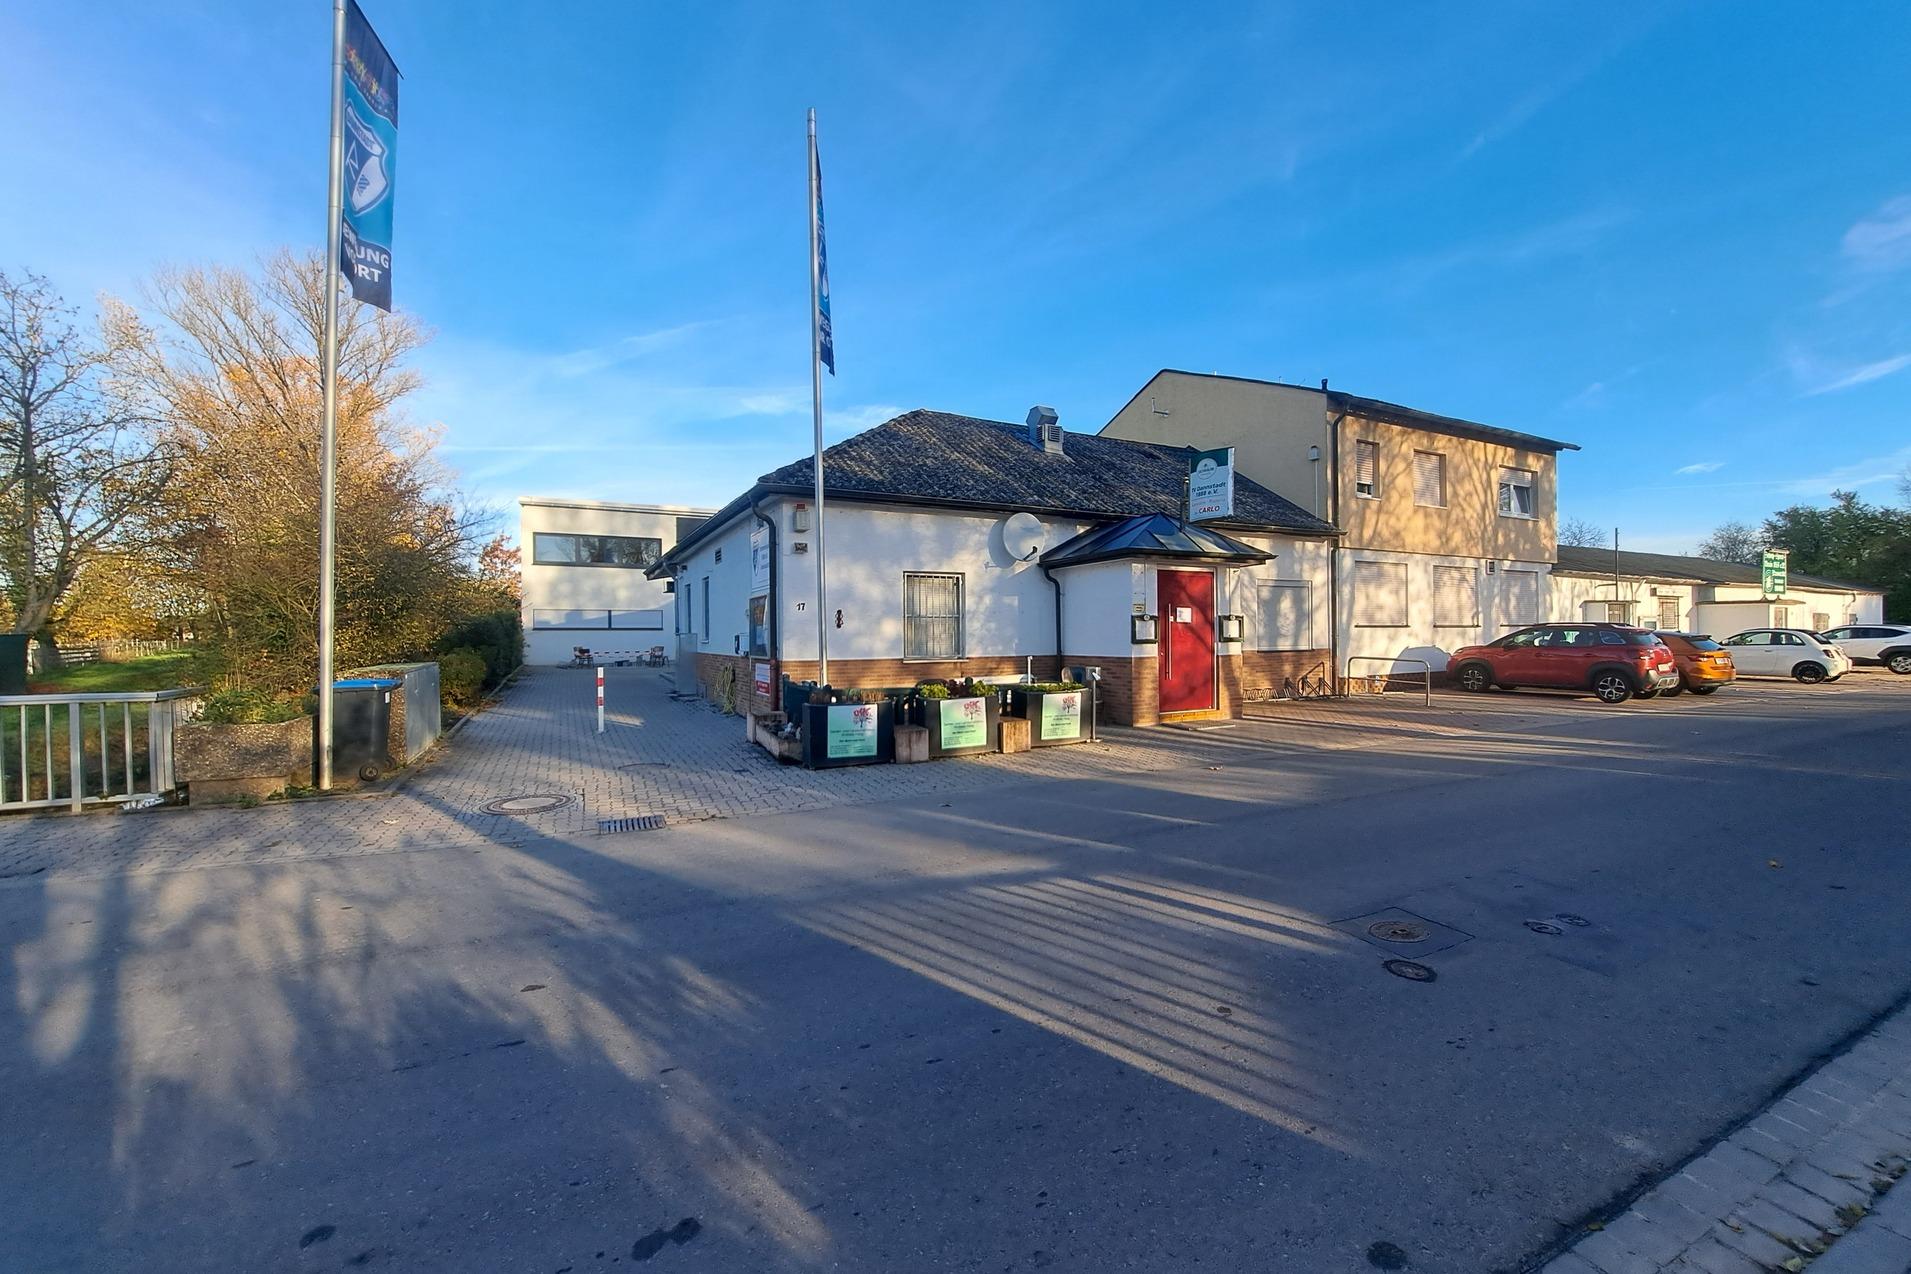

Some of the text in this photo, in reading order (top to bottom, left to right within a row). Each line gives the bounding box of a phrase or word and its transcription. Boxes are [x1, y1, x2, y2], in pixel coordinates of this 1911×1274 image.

[1197, 482, 1226, 491] Dannstadt
[1199, 506, 1220, 514] CARLO
[796, 603, 806, 611] 17
